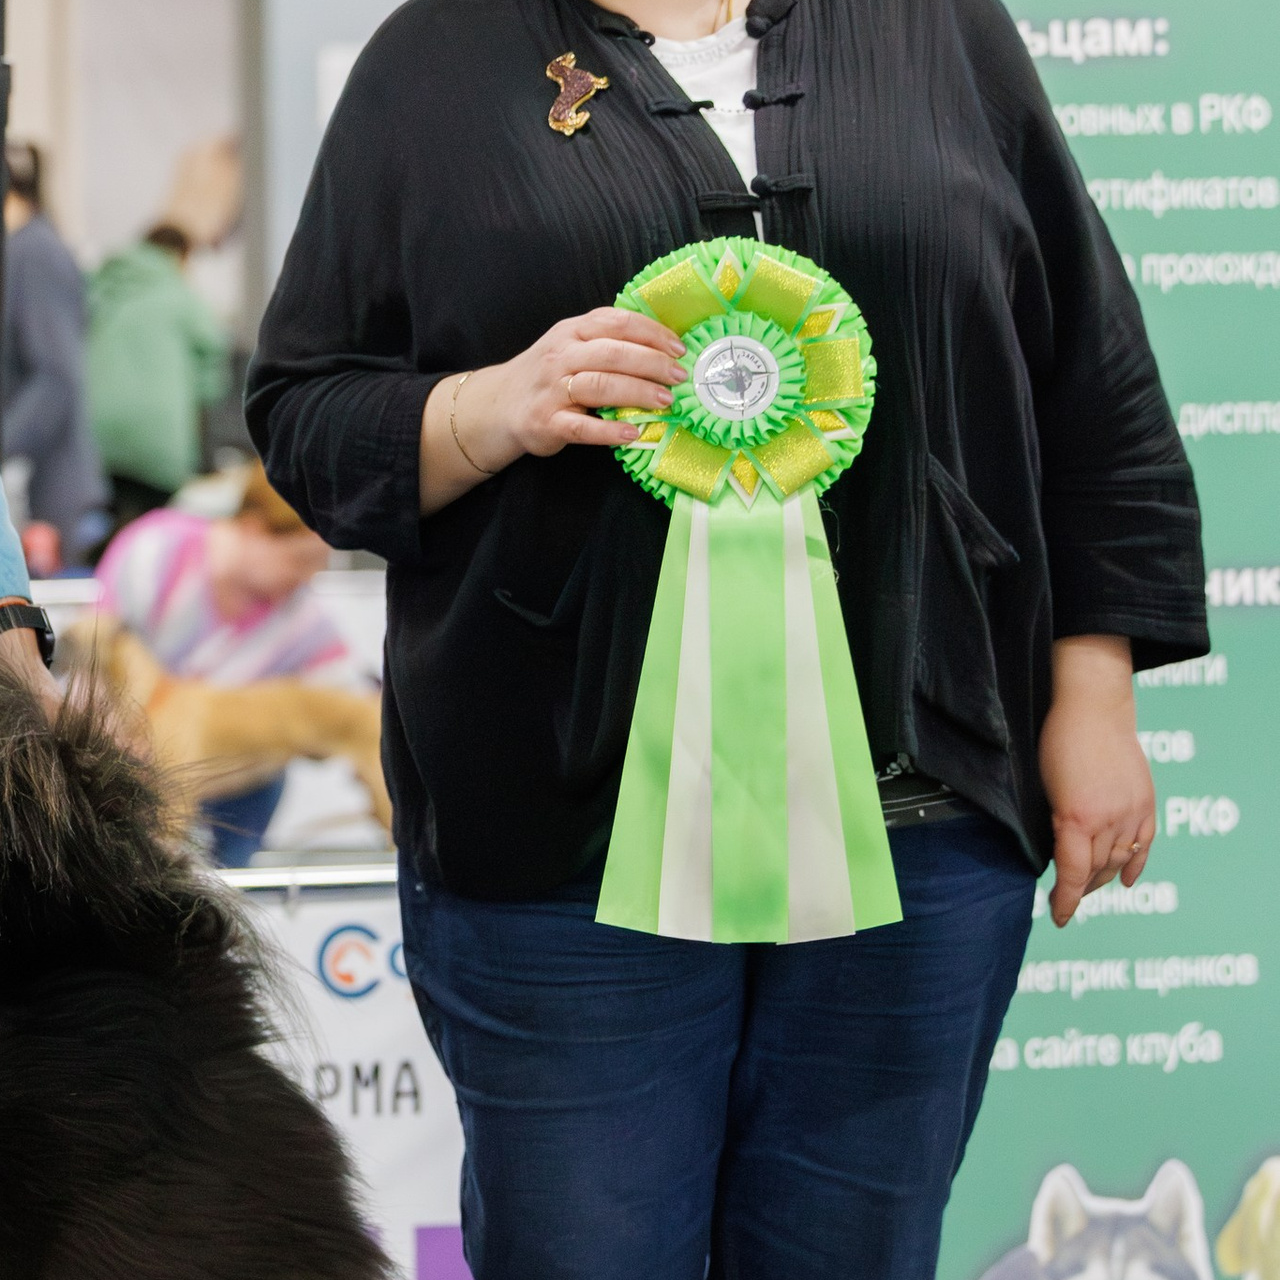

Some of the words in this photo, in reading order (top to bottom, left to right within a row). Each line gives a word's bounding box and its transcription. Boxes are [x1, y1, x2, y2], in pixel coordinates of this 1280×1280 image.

[1198, 91, 1274, 135] РКФ
[1140, 251, 1280, 295] прохожд
[1165, 794, 1240, 838] РКФ
[1125, 1020, 1225, 1075] клуба
